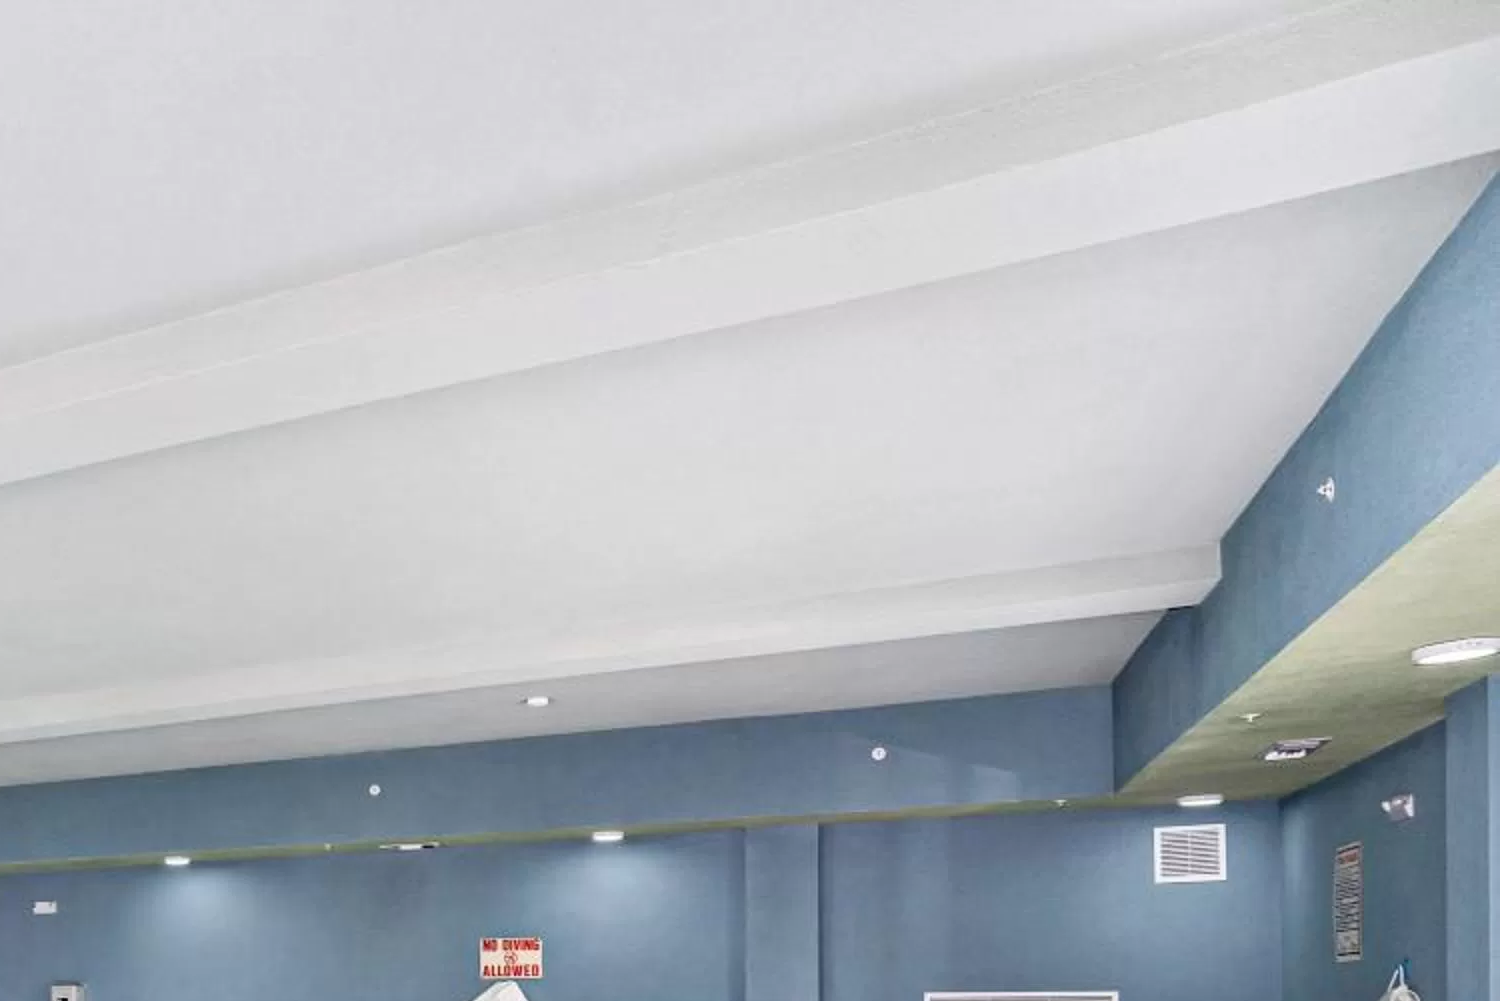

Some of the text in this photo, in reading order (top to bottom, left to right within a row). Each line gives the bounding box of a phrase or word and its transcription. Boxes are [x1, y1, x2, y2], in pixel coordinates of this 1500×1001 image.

[483, 939, 540, 951] NO DIVING
[483, 964, 540, 977] ALLOWED
